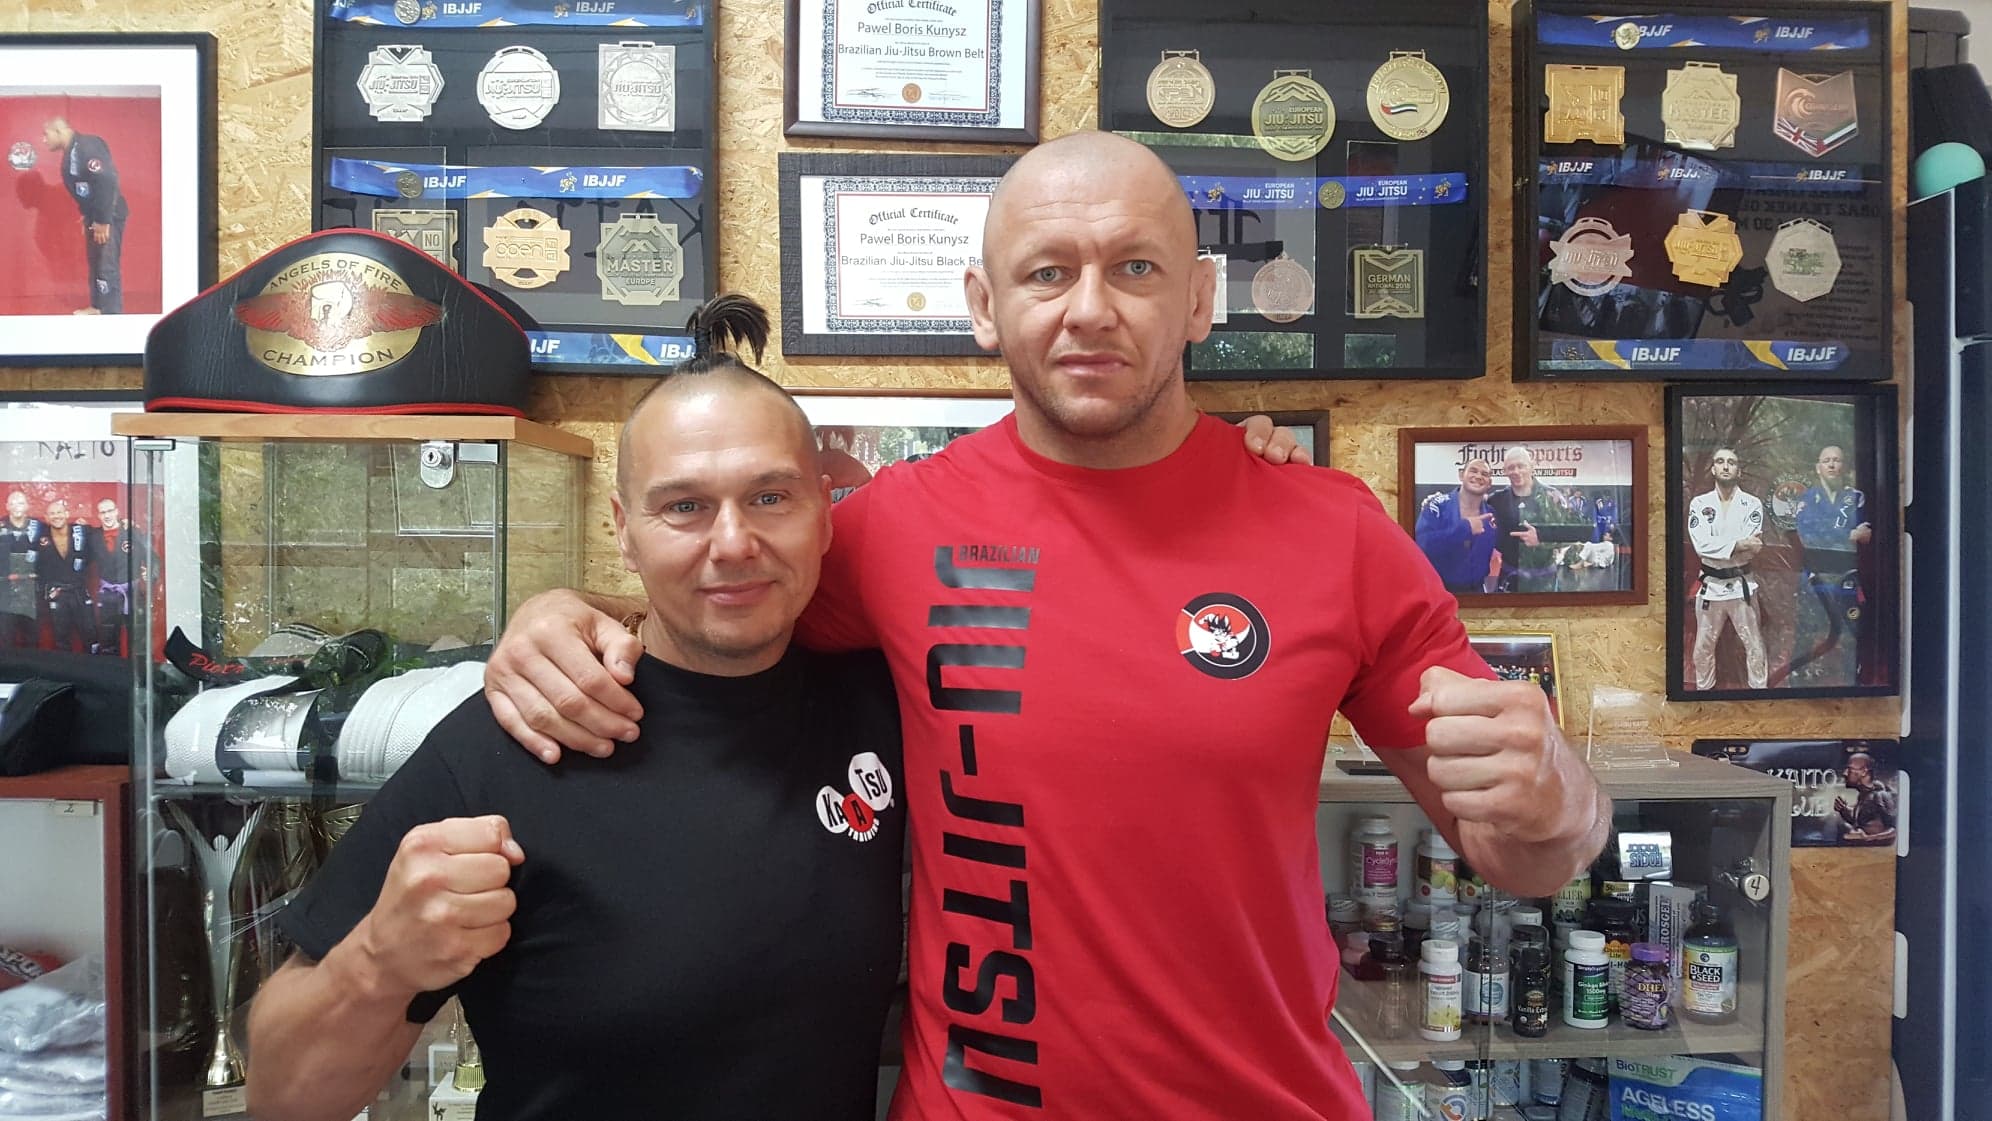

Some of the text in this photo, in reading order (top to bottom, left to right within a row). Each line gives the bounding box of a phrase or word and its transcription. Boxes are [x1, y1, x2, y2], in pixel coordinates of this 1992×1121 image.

[443, 2, 481, 14] IBJJF
[575, 1, 615, 13] IBJJF
[908, 0, 958, 17] Certificate
[857, 21, 967, 38] Pawel Boris Kunysz
[1639, 25, 1672, 37] BJJF
[1775, 26, 1814, 39] IBJJF
[838, 44, 985, 59] Brazilian Jiu-Jitsu Brown Belt
[1558, 161, 1593, 173] IBJJF
[583, 175, 626, 187] IBJJF
[1807, 169, 1847, 181] IBJJF
[423, 176, 467, 188] IBJJF
[1264, 189, 1295, 199] JITSU
[1378, 186, 1408, 196] JITSU
[868, 207, 959, 226] Official Certificate
[424, 233, 440, 247] NO
[860, 233, 969, 247] Pawel Boris Kunysz
[607, 259, 674, 274] MASTER
[841, 255, 983, 267] Brazilian Jiu-Jitsu Black Be
[269, 259, 402, 291] ANGELS OF FIRE
[1367, 274, 1411, 283] GERMAN
[625, 278, 656, 287] EUROPE
[262, 347, 394, 367] CHAMPION
[1631, 346, 1681, 362] IBJJF
[1787, 346, 1838, 362] IBJJF
[958, 545, 1041, 565] BRAZILIAN
[926, 546, 1043, 1109] JIU-JITSU
[1750, 876, 1761, 896] 4
[1690, 964, 1721, 975] BLACK
[1696, 974, 1721, 983] SEED
[1622, 1087, 1716, 1121] AGELESS
